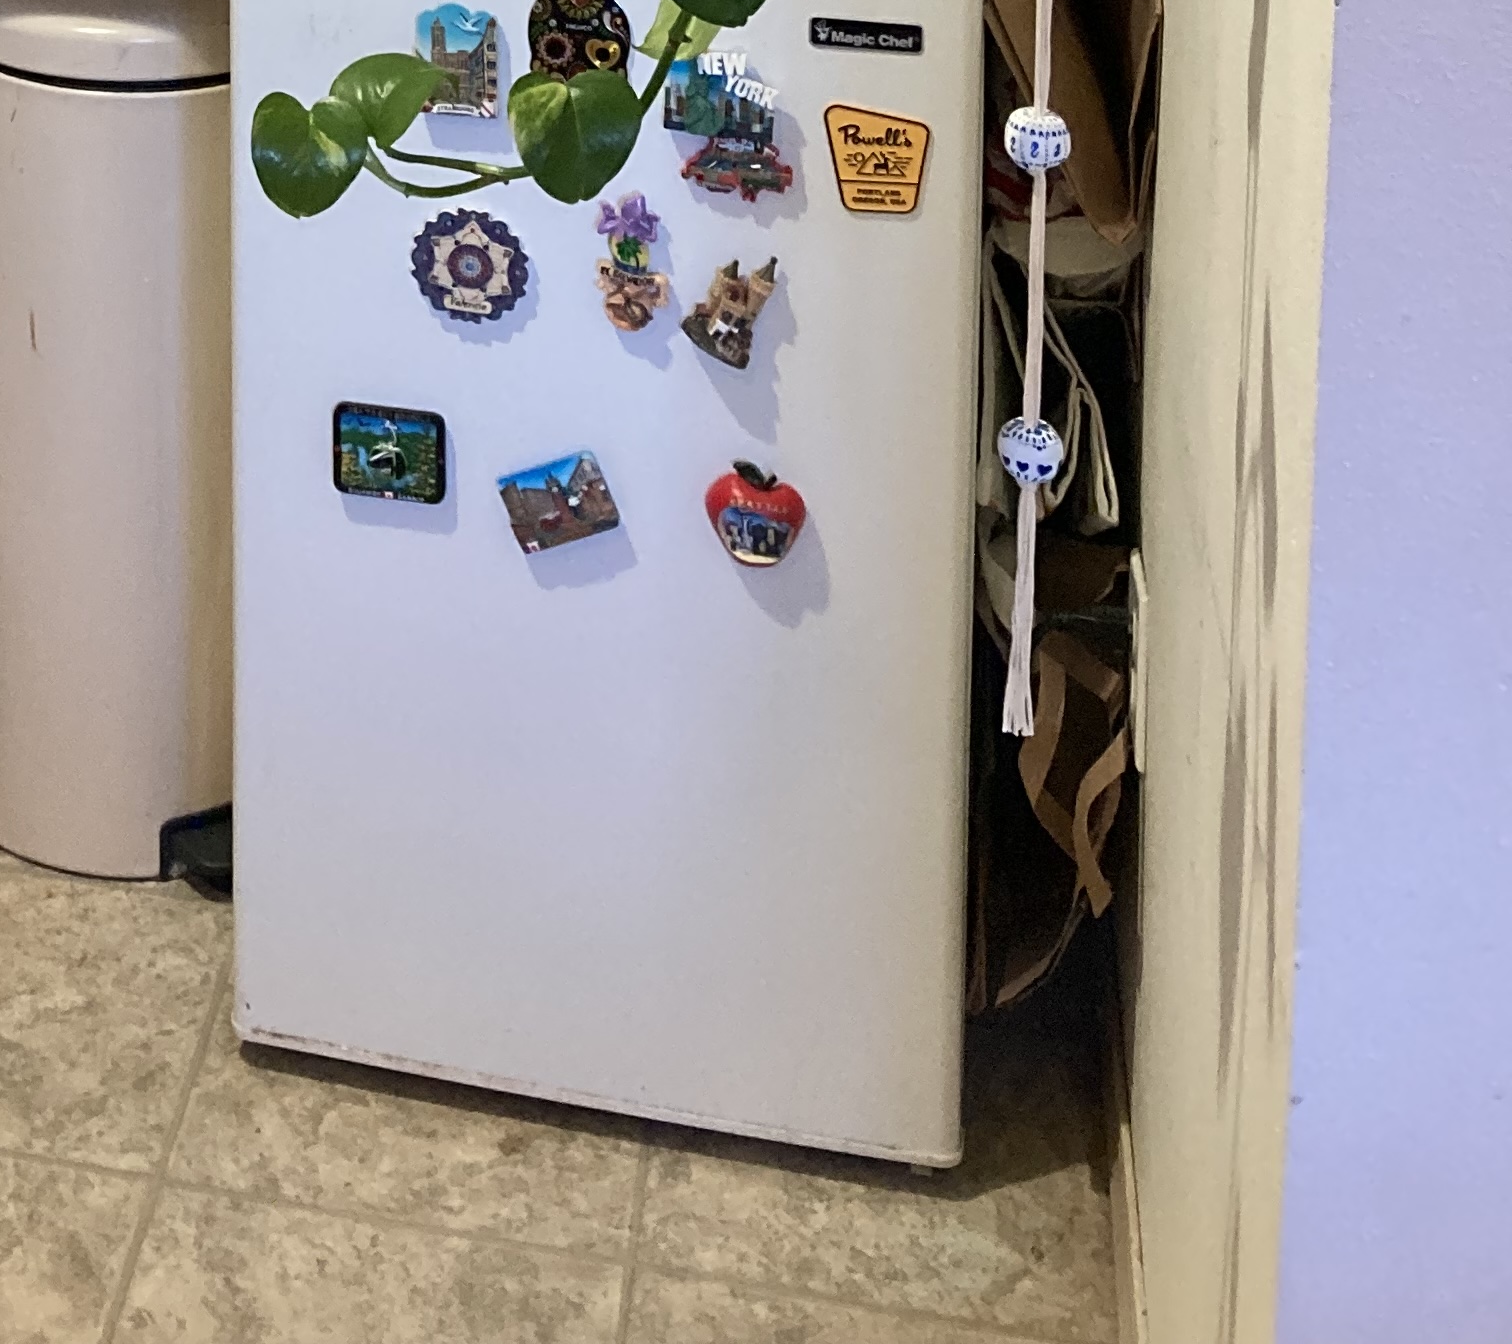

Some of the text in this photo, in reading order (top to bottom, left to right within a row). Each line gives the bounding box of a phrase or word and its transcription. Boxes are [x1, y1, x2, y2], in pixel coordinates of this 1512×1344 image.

[831, 28, 914, 48] Magic Chef
[696, 53, 748, 76] NEW
[724, 75, 780, 110] YORK
[838, 124, 913, 148] Powell's
[857, 188, 901, 197] PORTLAND
[888, 198, 907, 206] USA
